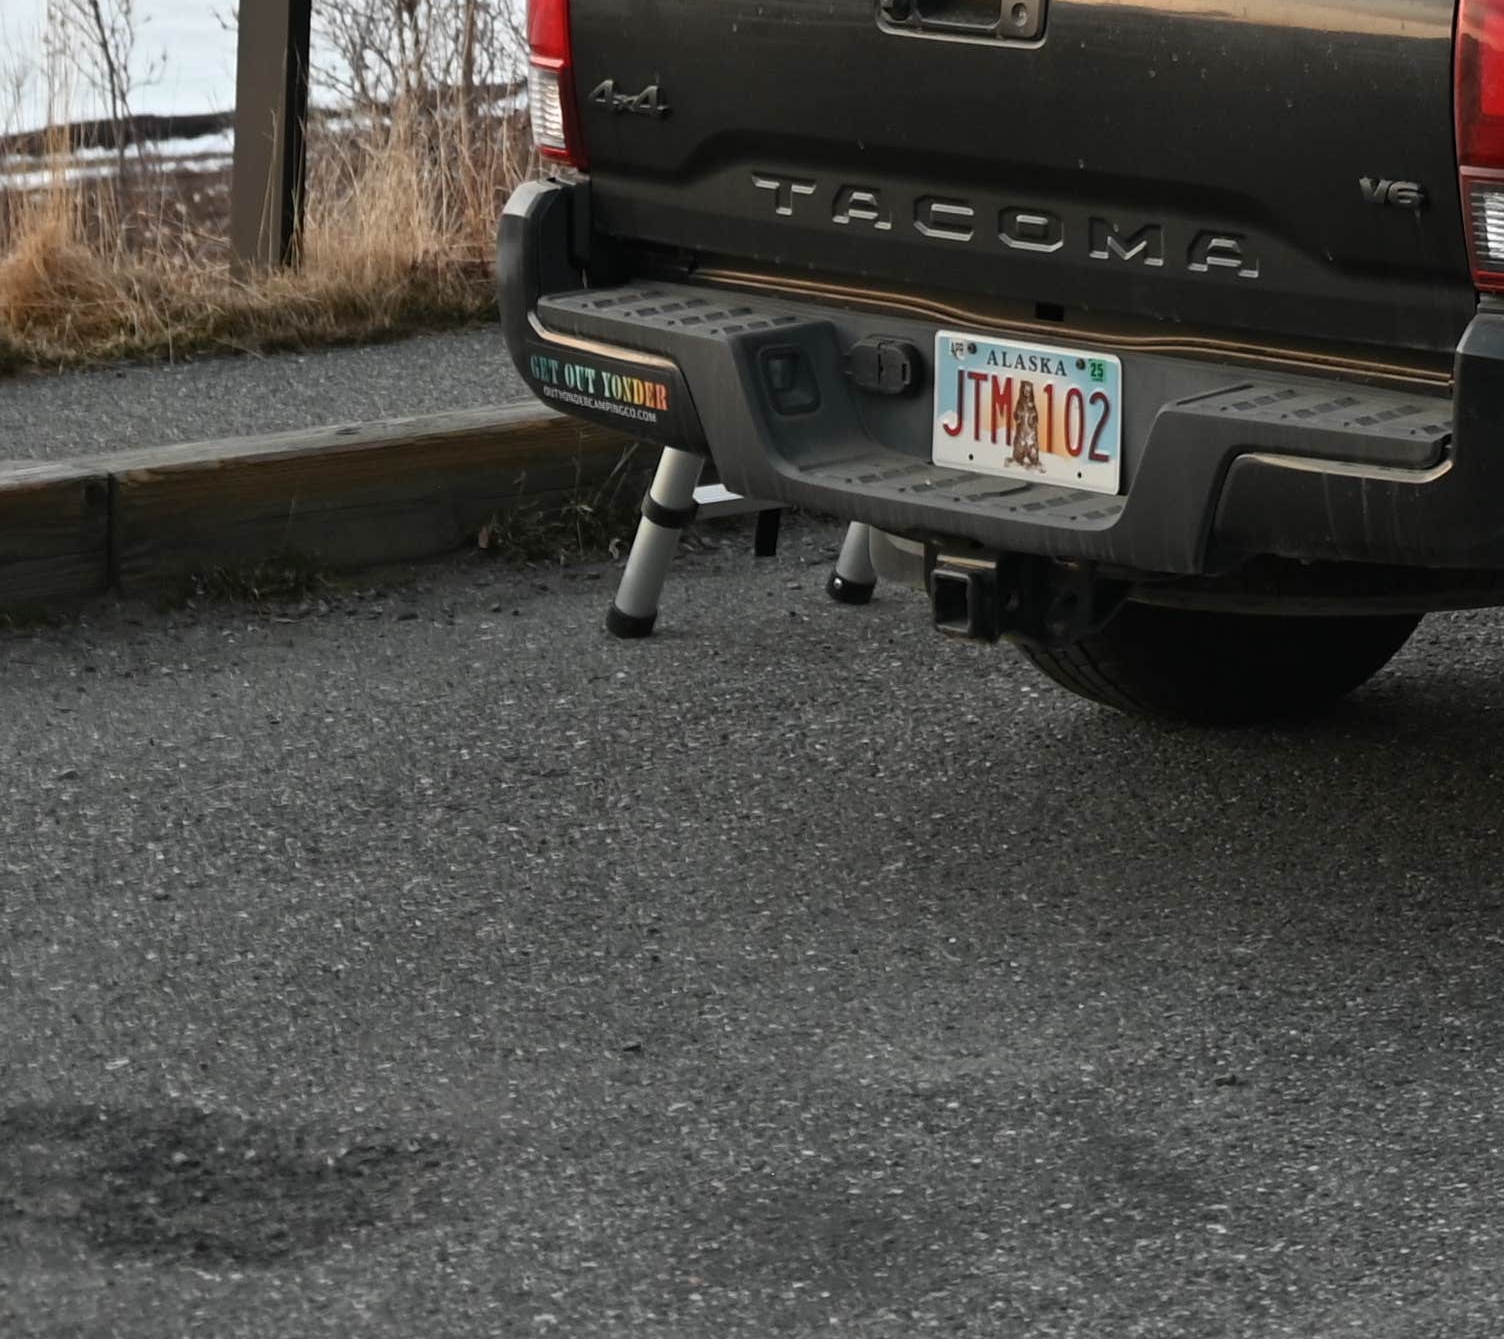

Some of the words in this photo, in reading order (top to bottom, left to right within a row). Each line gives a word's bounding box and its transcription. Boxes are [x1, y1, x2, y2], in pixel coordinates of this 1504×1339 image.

[1359, 177, 1424, 209] V6
[751, 170, 1260, 279] TACOMA
[530, 354, 559, 384] GET
[564, 362, 596, 394] OUT
[601, 371, 669, 411] YONDER
[987, 350, 1067, 376] ALASKA
[1090, 361, 1104, 378] 25
[943, 369, 1014, 446] JTM
[1043, 383, 1111, 463] 102
